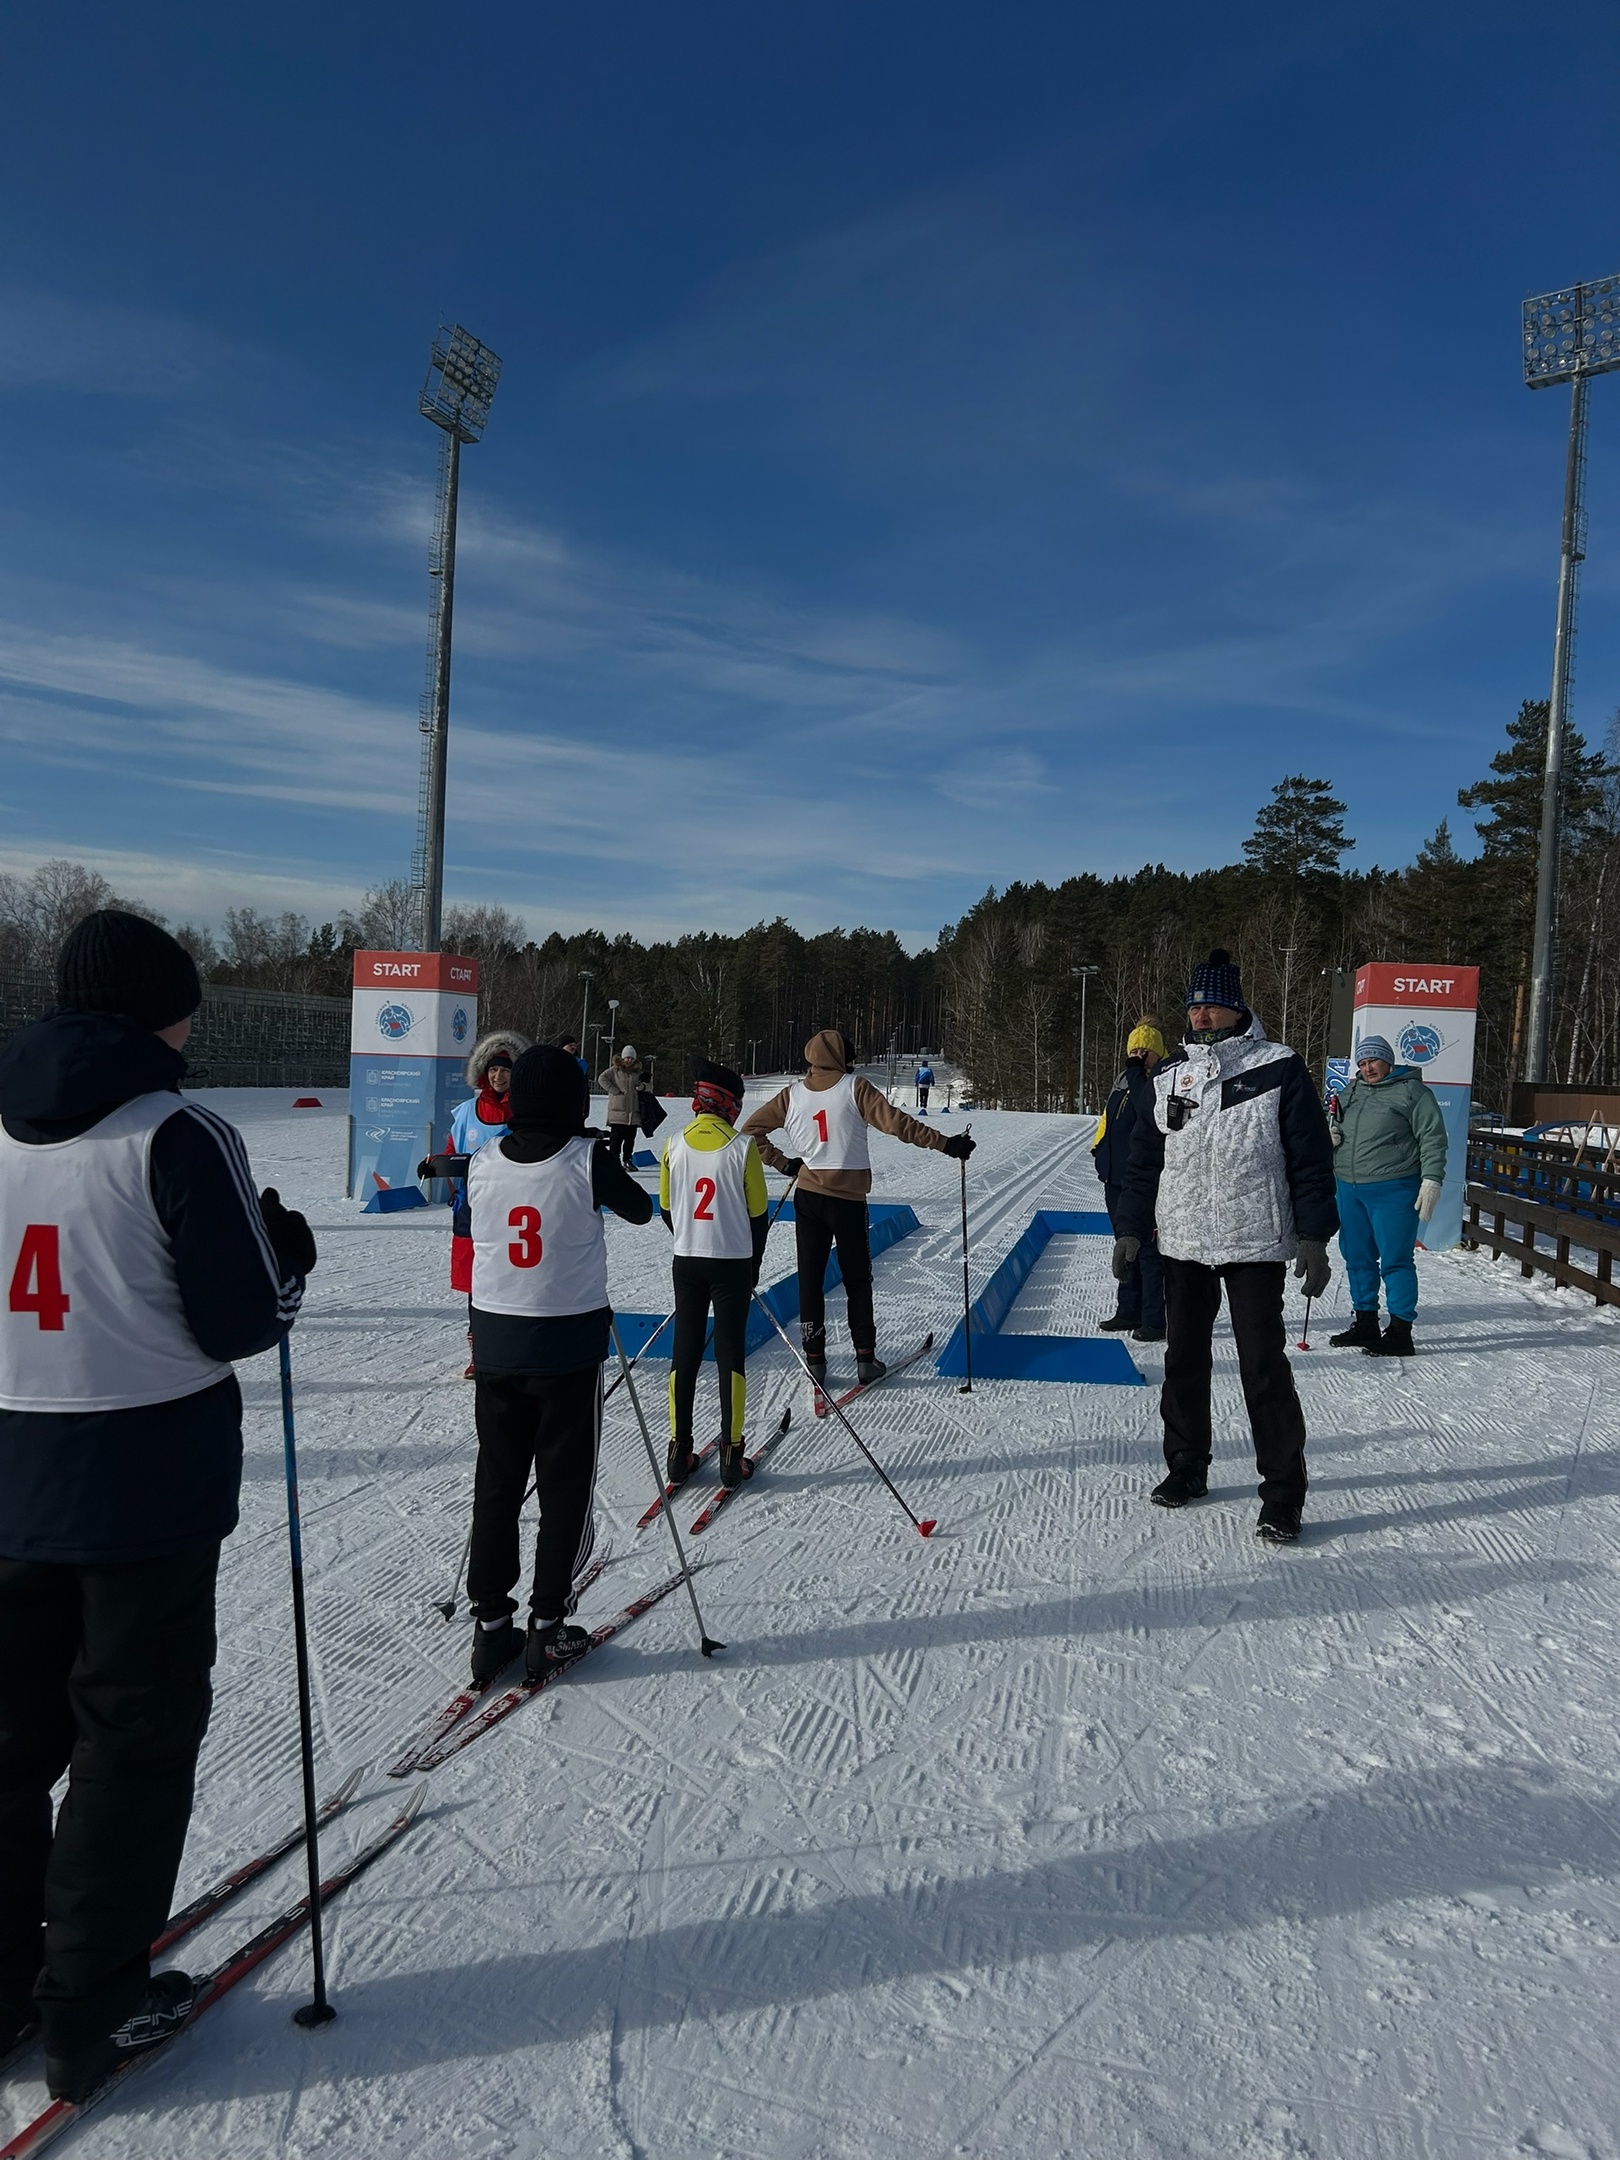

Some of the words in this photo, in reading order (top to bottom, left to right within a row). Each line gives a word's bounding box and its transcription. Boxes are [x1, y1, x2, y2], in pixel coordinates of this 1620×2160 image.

[373, 963, 421, 976] START
[1393, 978, 1455, 994] START
[813, 1109, 828, 1142] 1
[693, 1177, 716, 1221] 2
[507, 1205, 543, 1269] 3
[9, 1224, 70, 1332] 4
[555, 1638, 587, 1652] SMART
[116, 1999, 193, 2033] SPINE
